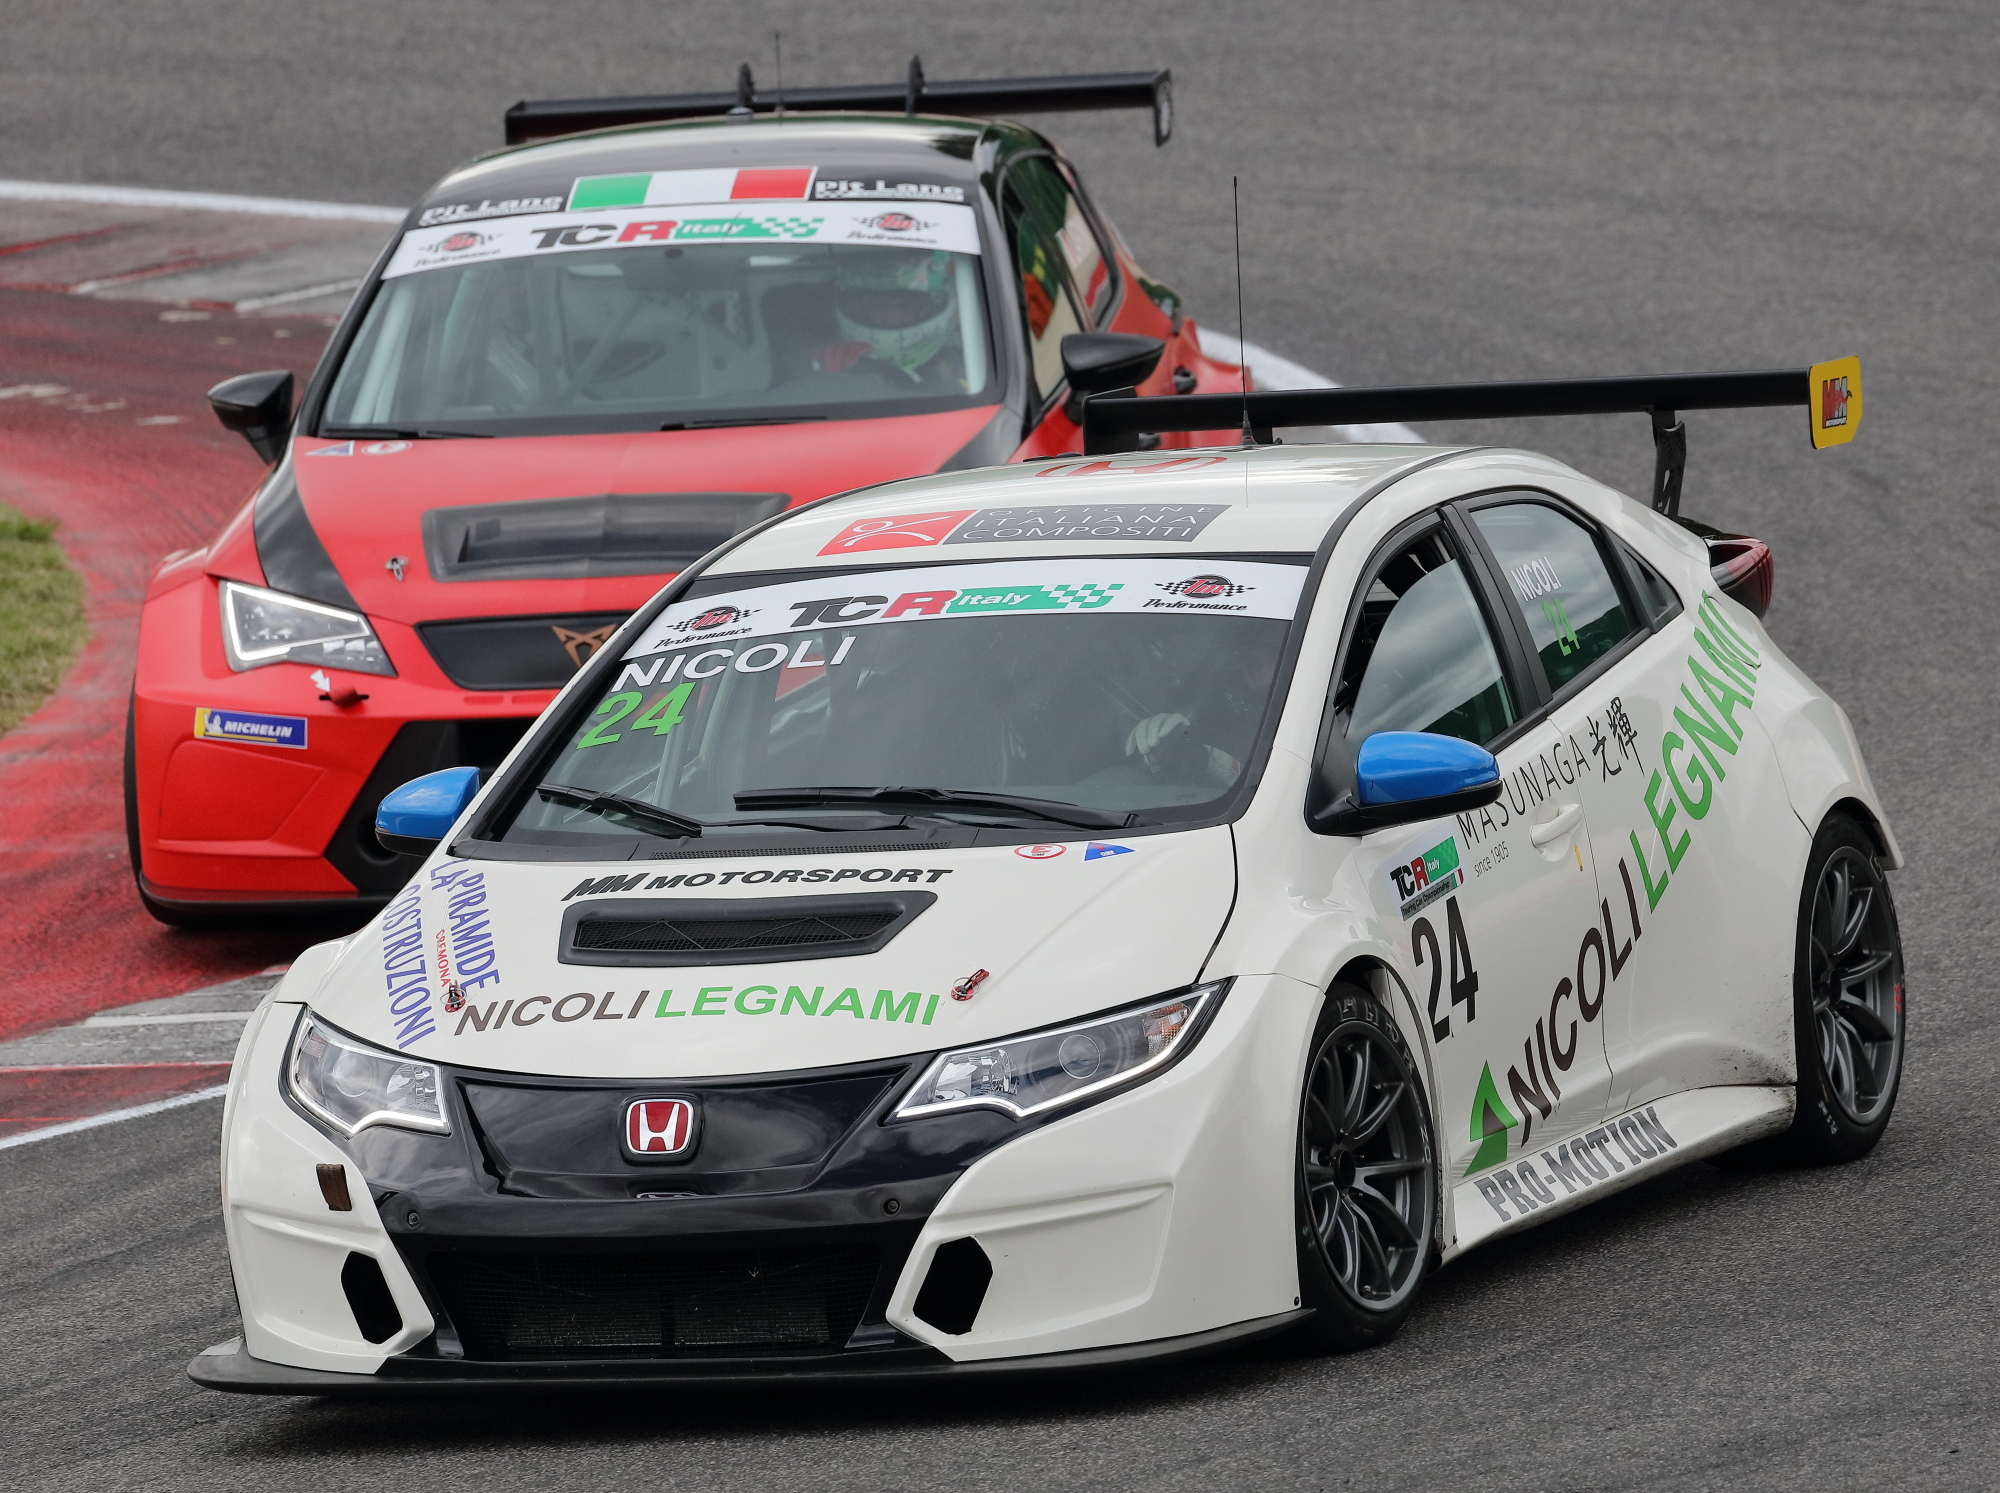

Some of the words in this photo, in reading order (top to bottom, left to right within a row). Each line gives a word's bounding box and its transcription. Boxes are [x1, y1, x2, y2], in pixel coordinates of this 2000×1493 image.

[531, 220, 679, 249] TCR
[681, 221, 747, 236] Italy
[962, 526, 1192, 540] COMPOSITI
[974, 515, 1197, 528] ITALIANA
[988, 506, 1215, 517] OFFICINE
[1510, 556, 1561, 602] NICOLI
[789, 590, 957, 628] TCR
[957, 592, 1033, 606] Italy
[1142, 598, 1248, 611] Performance
[1542, 597, 1580, 657] 24
[653, 627, 753, 650] Performance
[610, 636, 857, 692] NICOLI
[224, 720, 293, 738] MICHELIN
[576, 682, 697, 750] 24
[1456, 734, 1591, 850] MASUNAGA
[1390, 856, 1430, 902] TCR
[1427, 857, 1440, 873] Italy
[1474, 856, 1492, 878] since
[1490, 840, 1509, 865] 1905
[1507, 857, 1642, 1148] NICOLI
[1629, 589, 1760, 915] LEGNAMI
[560, 873, 653, 902] MM
[643, 868, 953, 890] MOTORSPORT
[1423, 880, 1451, 903] Championship
[446, 872, 501, 998] PIRAMIDE
[382, 884, 437, 1051] COSTRUZIONI
[435, 929, 452, 988] CREMONA
[1411, 895, 1479, 1044] 24
[453, 990, 650, 1036] NICOLI
[654, 984, 941, 1026] LEGNAMI
[1473, 1105, 1678, 1223] PRO-MOTION
